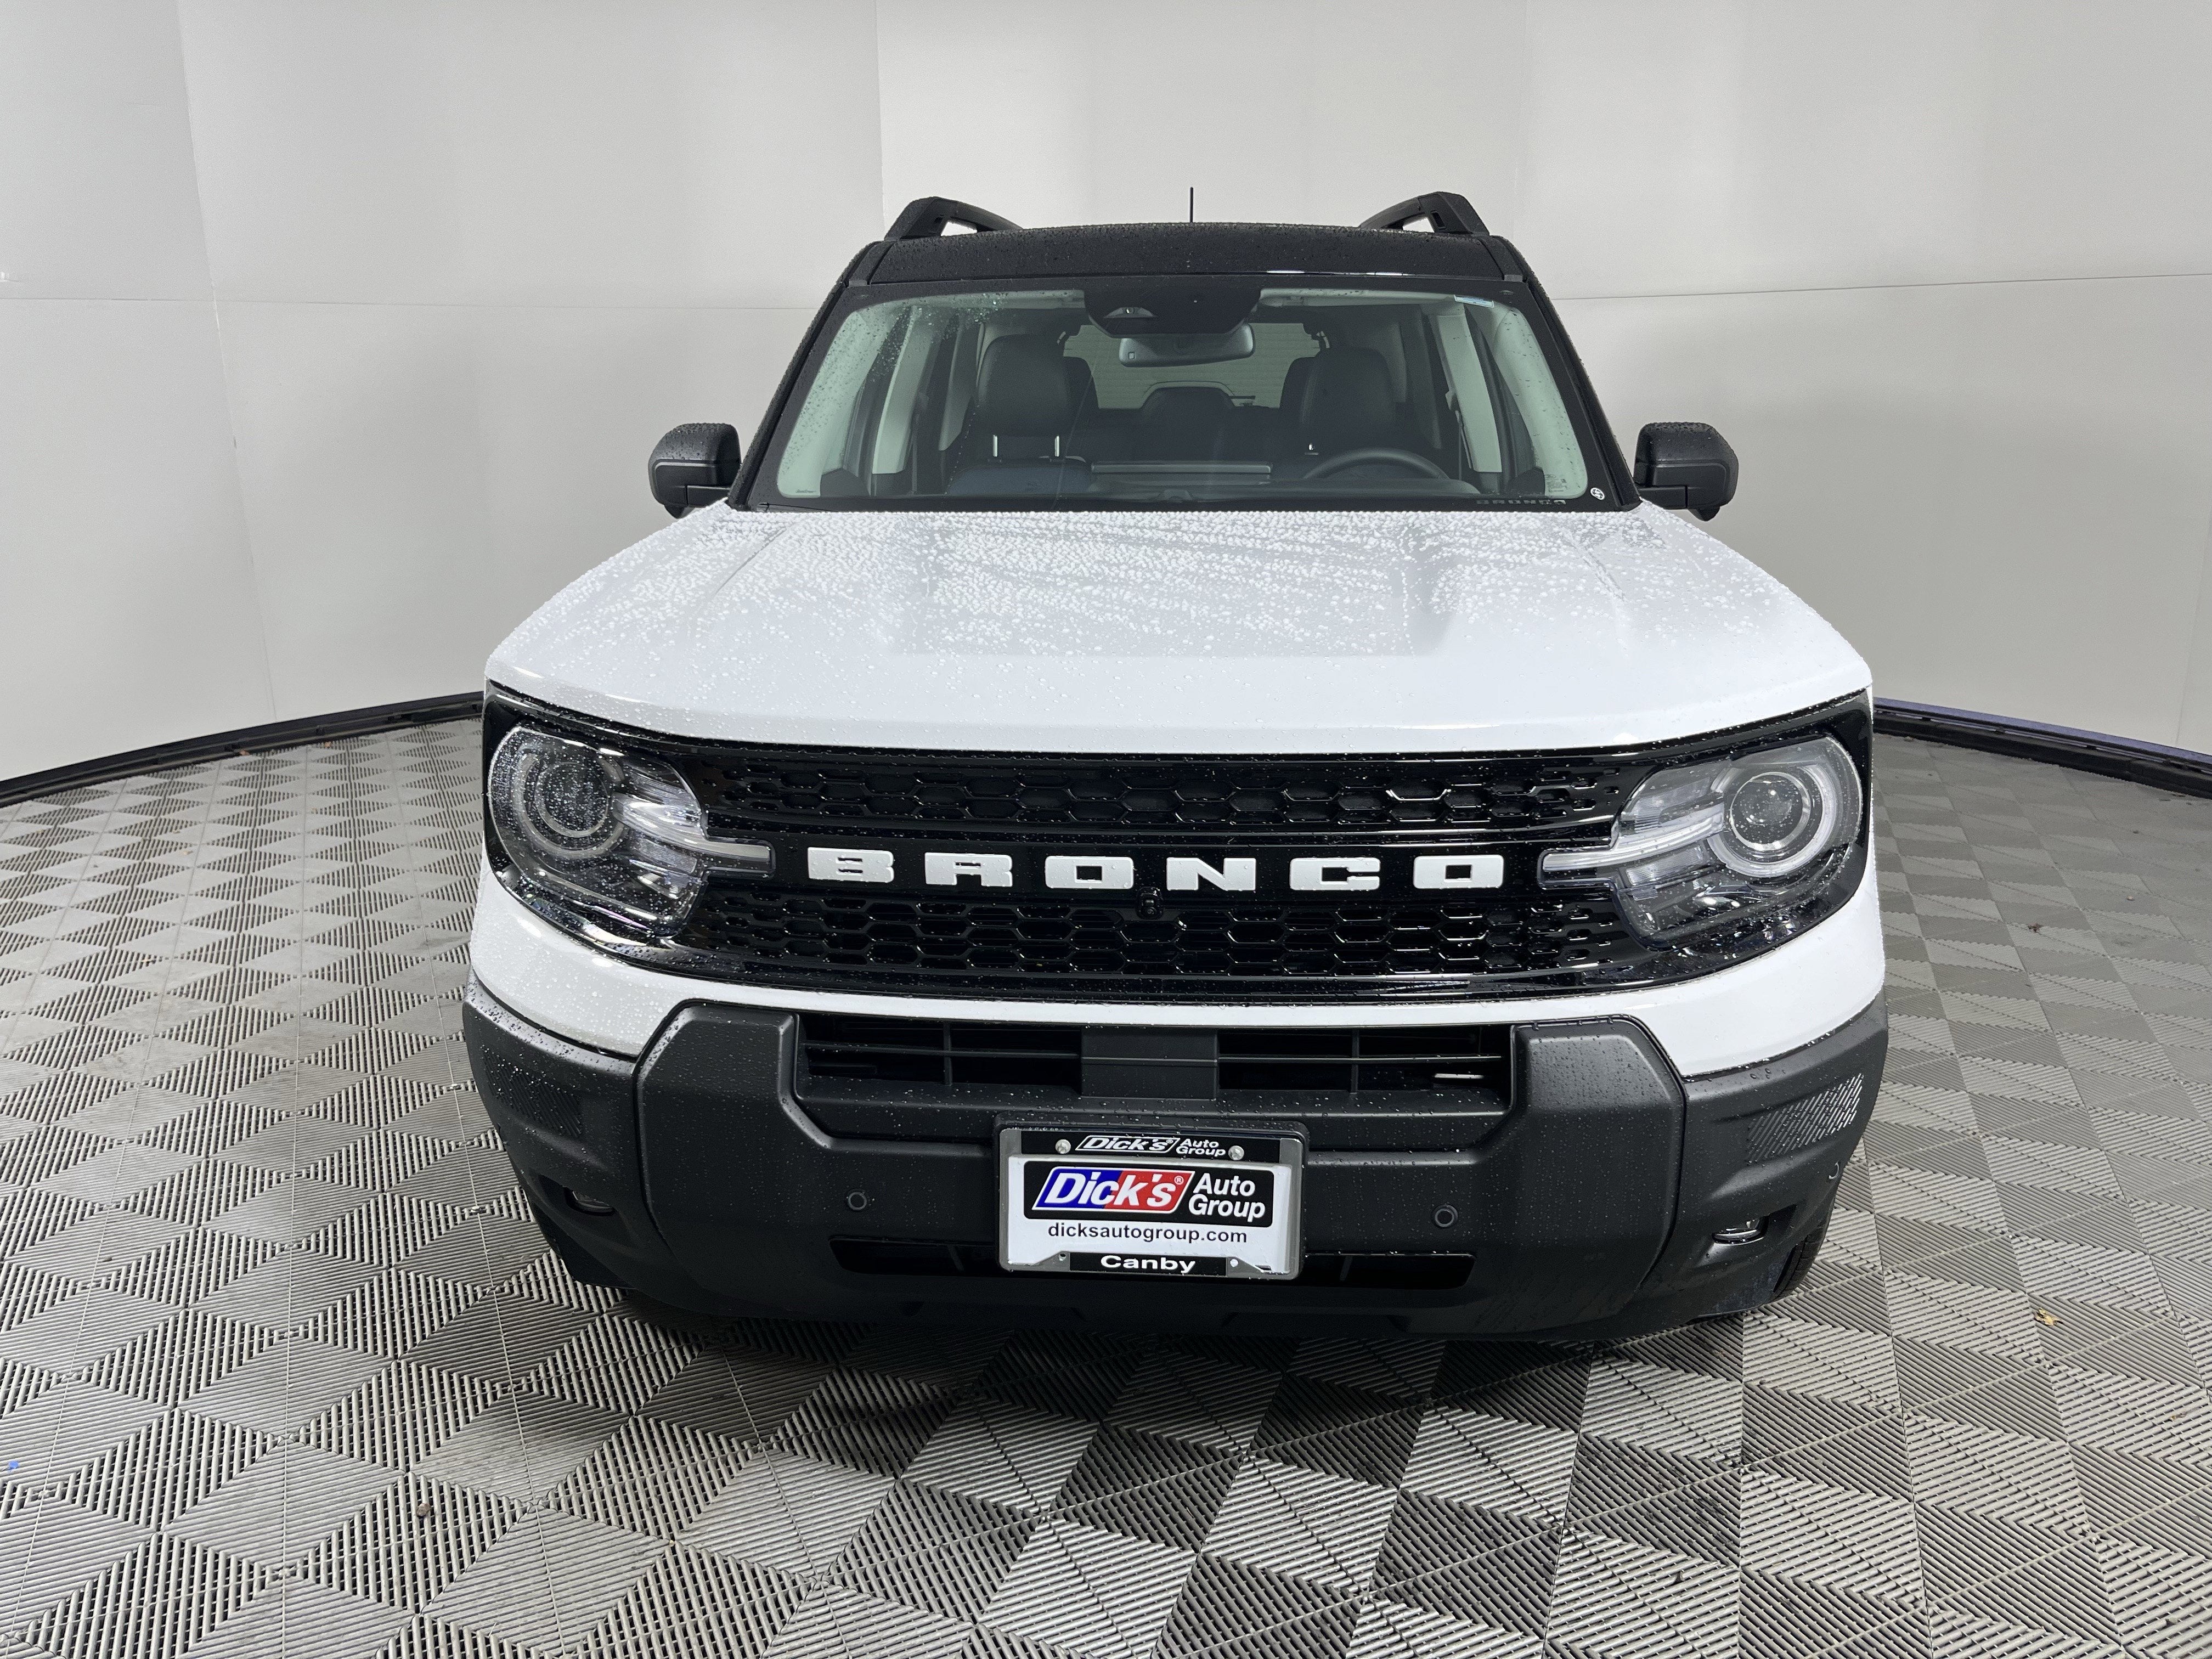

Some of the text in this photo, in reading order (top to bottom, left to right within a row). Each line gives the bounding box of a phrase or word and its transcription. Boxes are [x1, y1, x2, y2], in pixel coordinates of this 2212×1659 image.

[807, 847, 1504, 890] BRONCO
[1176, 1146, 1226, 1157] Group
[1180, 1138, 1219, 1148] Auto
[1194, 1173, 1255, 1197] Auto
[1188, 1197, 1266, 1222] Group
[1048, 1223, 1247, 1243] dicksautogroup.com
[1101, 1255, 1196, 1274] Canby
